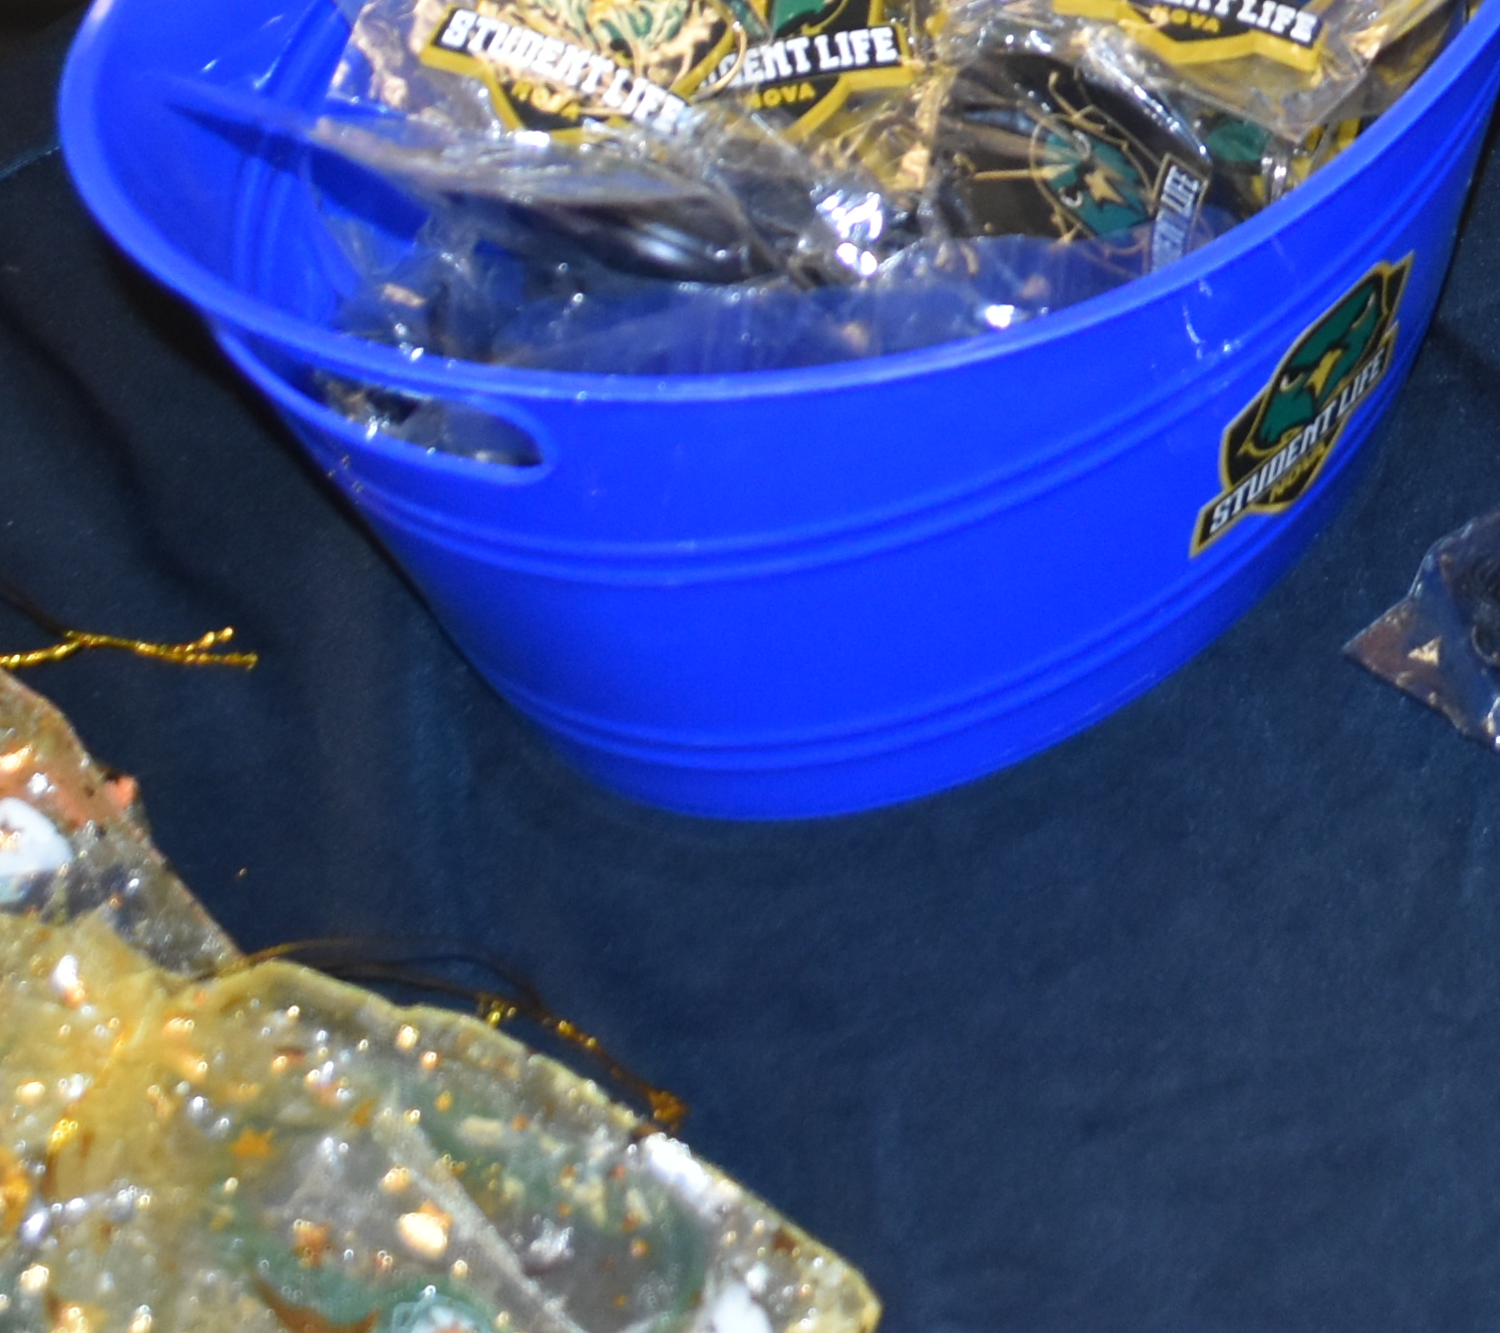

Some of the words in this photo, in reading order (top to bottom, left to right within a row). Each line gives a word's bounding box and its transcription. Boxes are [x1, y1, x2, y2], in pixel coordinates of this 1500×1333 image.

[440, 8, 615, 94] STUDENT
[814, 26, 899, 71] LIFE
[1209, 399, 1338, 534] STUDENT
[1337, 346, 1385, 418] LIFE
